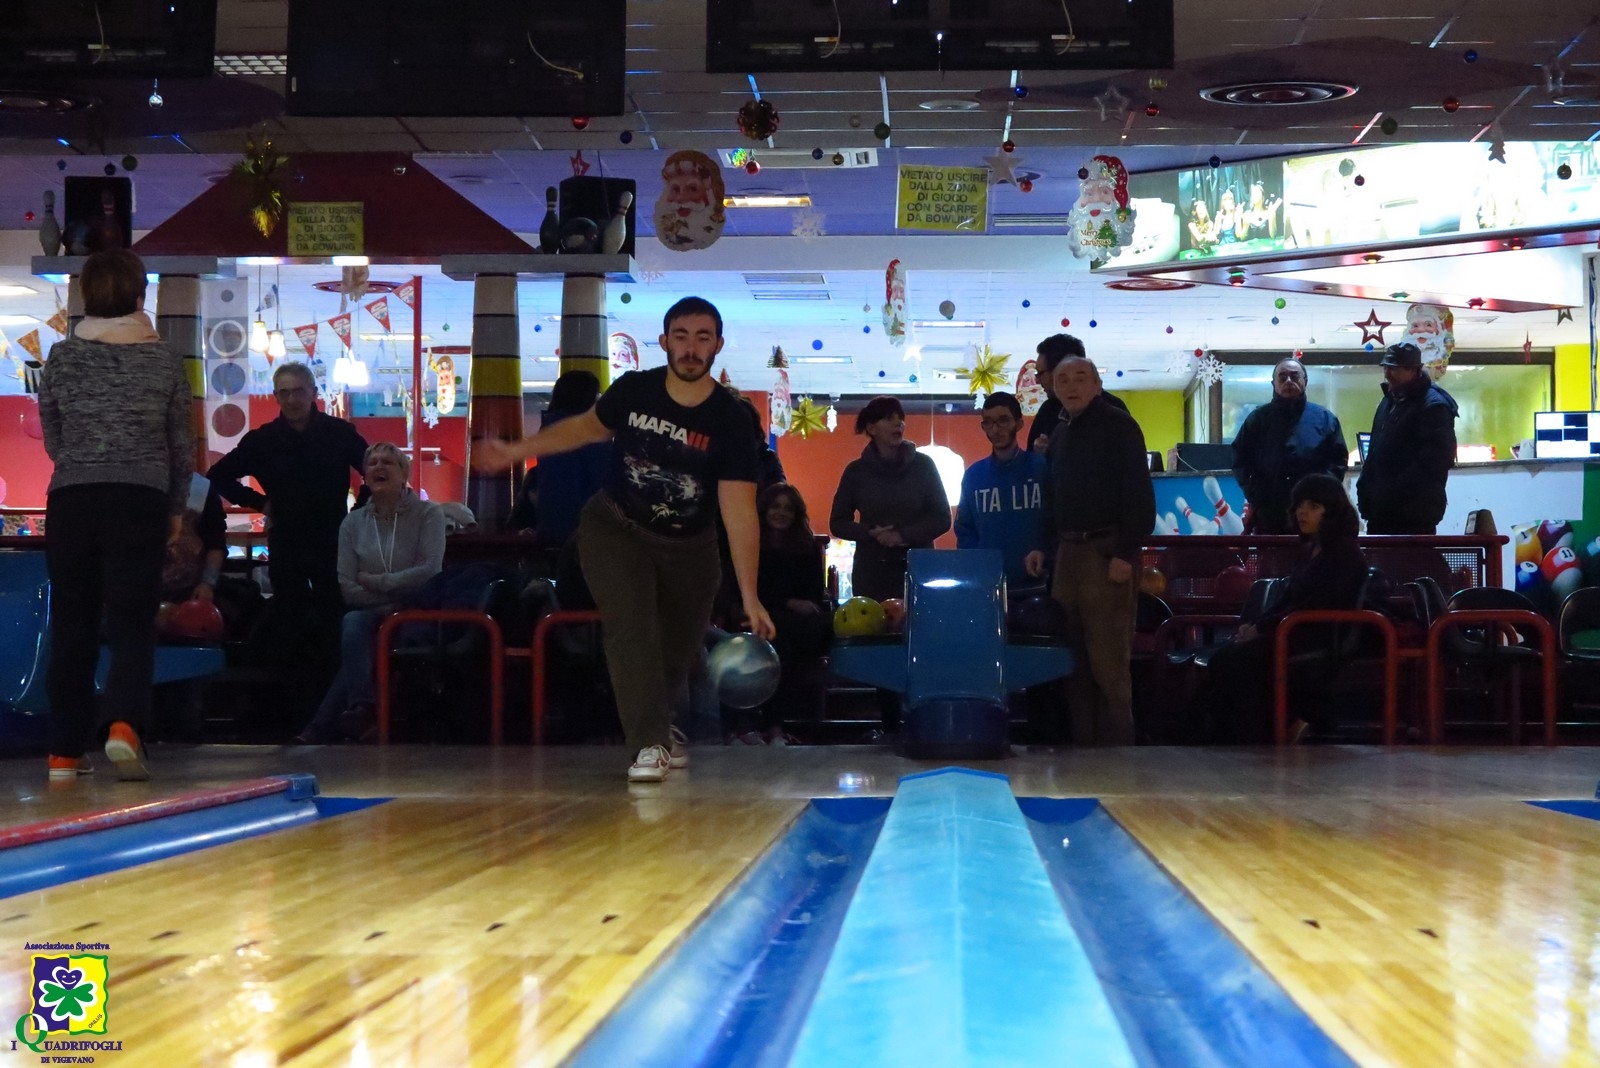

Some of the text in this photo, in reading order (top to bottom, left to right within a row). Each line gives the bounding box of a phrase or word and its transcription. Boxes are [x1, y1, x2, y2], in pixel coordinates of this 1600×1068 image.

[900, 170, 988, 182] VIETATO USCIRE
[909, 181, 978, 192] DALLA ZONA
[917, 192, 968, 203] DI GIOCO
[906, 202, 978, 213] CON SCARPE
[296, 215, 326, 224] DALLA
[906, 213, 976, 224] DA BOWLING
[304, 225, 314, 233] DI
[295, 233, 316, 242] CON
[296, 242, 356, 251] DA BOWLING
[628, 411, 688, 445] MAFIA
[1561, 549, 1573, 558] 11
